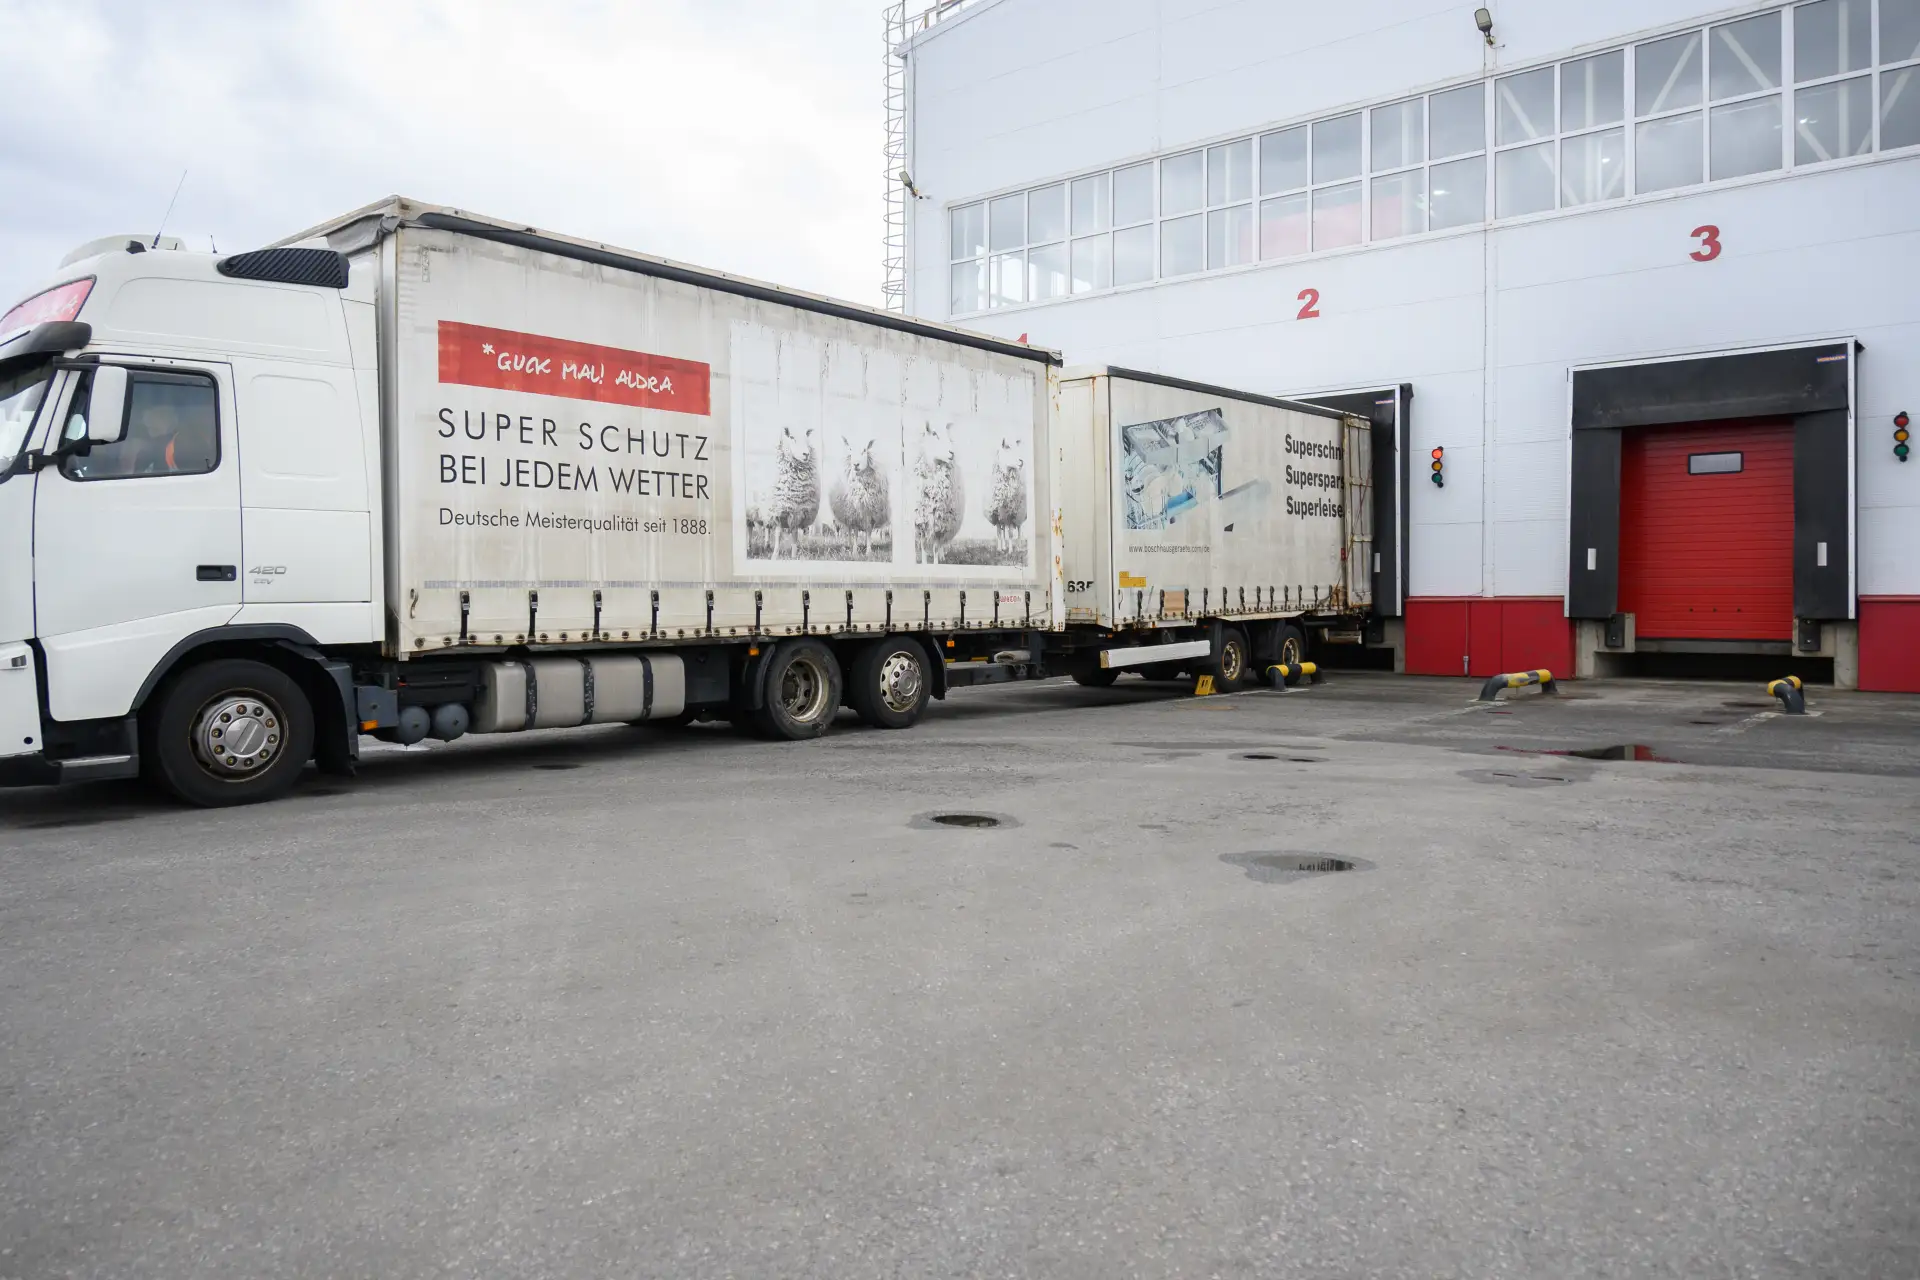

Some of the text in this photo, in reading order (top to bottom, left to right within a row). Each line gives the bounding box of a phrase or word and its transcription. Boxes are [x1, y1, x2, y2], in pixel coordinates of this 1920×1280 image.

[1689, 224, 1722, 262] 3
[1296, 288, 1320, 320] 2
[561, 362, 604, 385] MAL!
[437, 407, 709, 461] SUPER SCHUTZ
[1285, 433, 1344, 461] Superschn
[440, 454, 710, 499] BEI JEDEM WETTER
[439, 508, 711, 535] Deutsche Meisterqualität seit 1888.
[249, 565, 287, 574] 420
